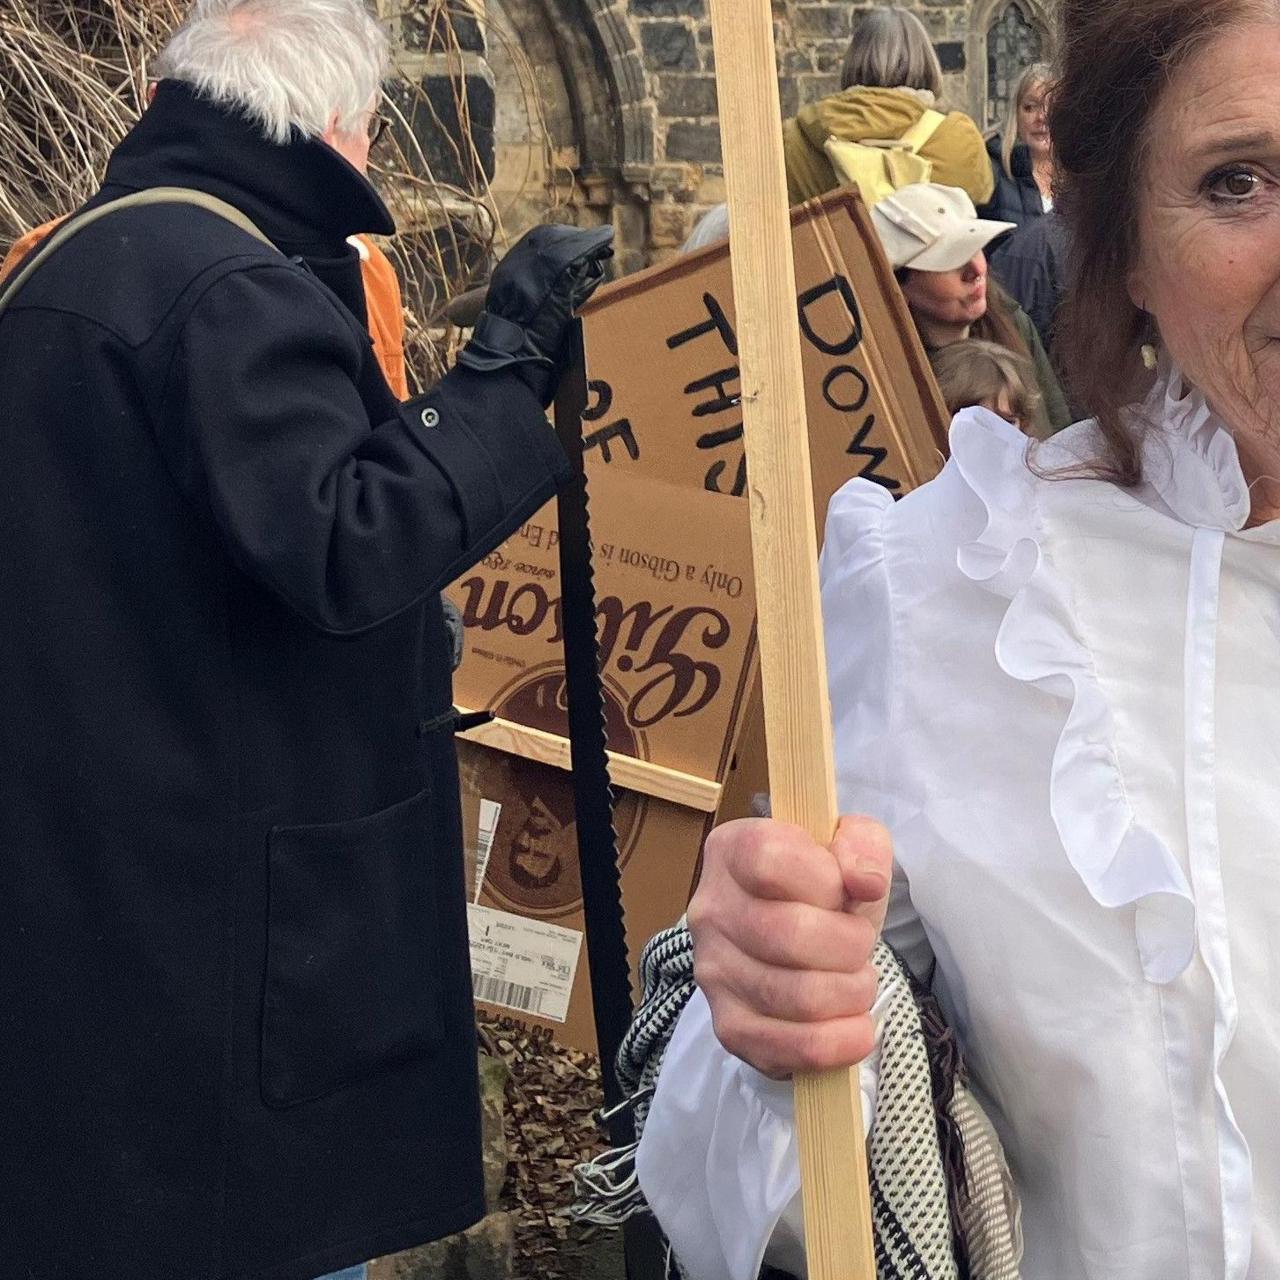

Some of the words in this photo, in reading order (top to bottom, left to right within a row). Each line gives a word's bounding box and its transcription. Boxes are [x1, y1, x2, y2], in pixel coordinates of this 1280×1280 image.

[797, 273, 903, 502] DOW
[599, 542, 615, 567] is
[619, 548, 681, 582] Gibson
[685, 564, 696, 581] a
[701, 564, 743, 599] Only
